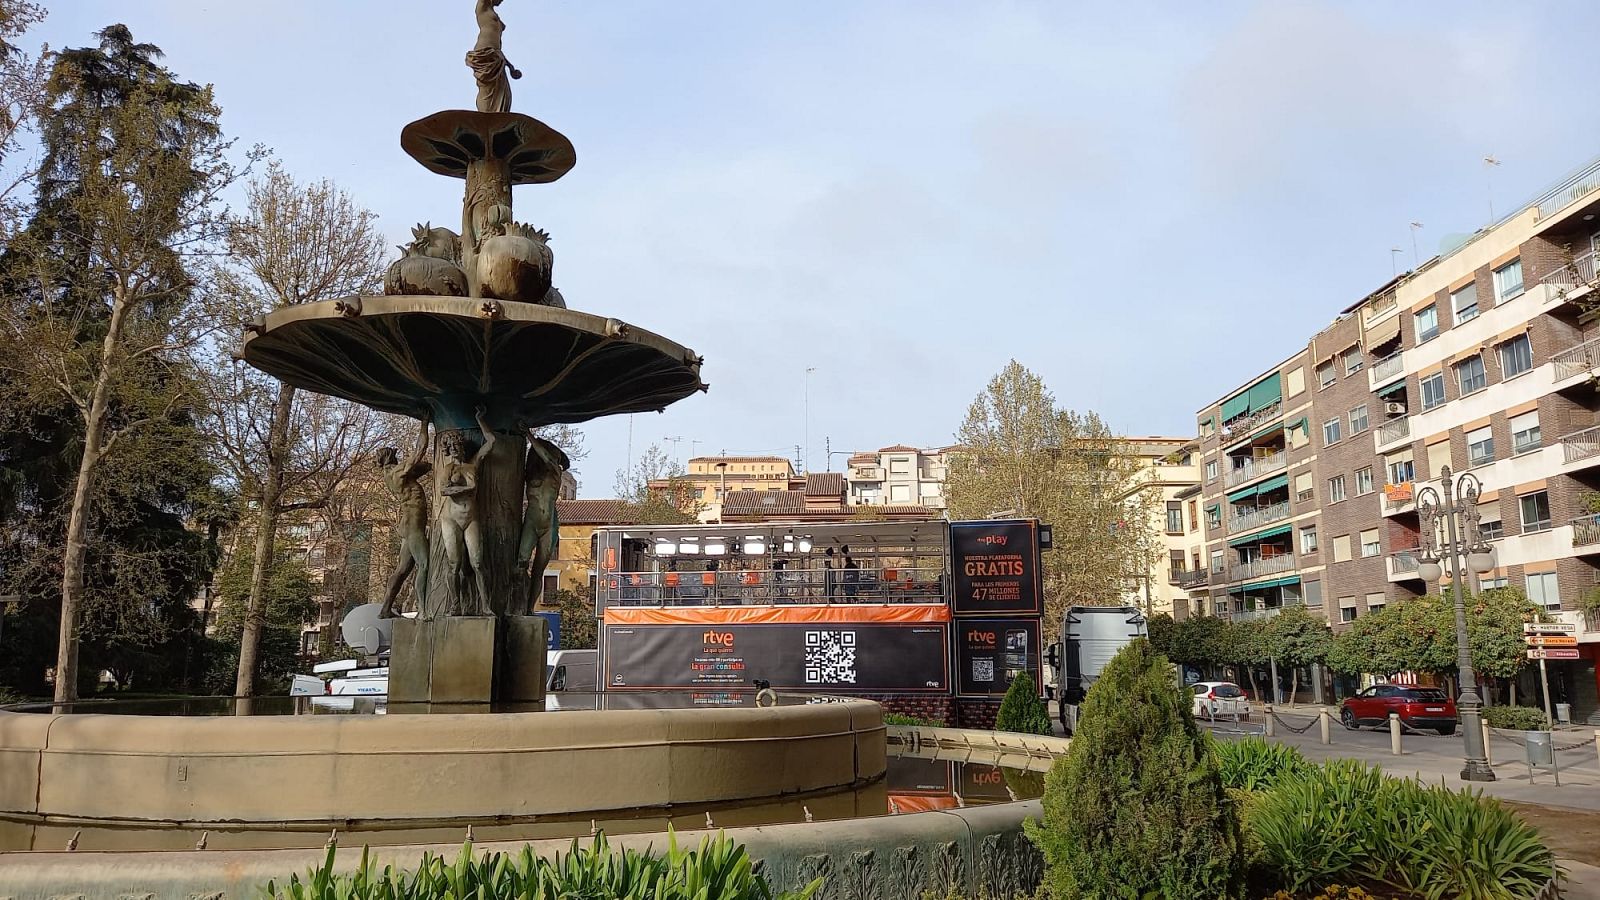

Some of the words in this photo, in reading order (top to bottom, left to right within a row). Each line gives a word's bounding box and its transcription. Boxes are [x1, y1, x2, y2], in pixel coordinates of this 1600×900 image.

[986, 534, 1008, 546] play
[964, 561, 1024, 577] GRATIS
[972, 588, 987, 601] 47
[703, 630, 734, 647] rtve
[968, 629, 996, 644] rtve
[716, 662, 745, 670] consulta
[926, 680, 940, 688] rtve
